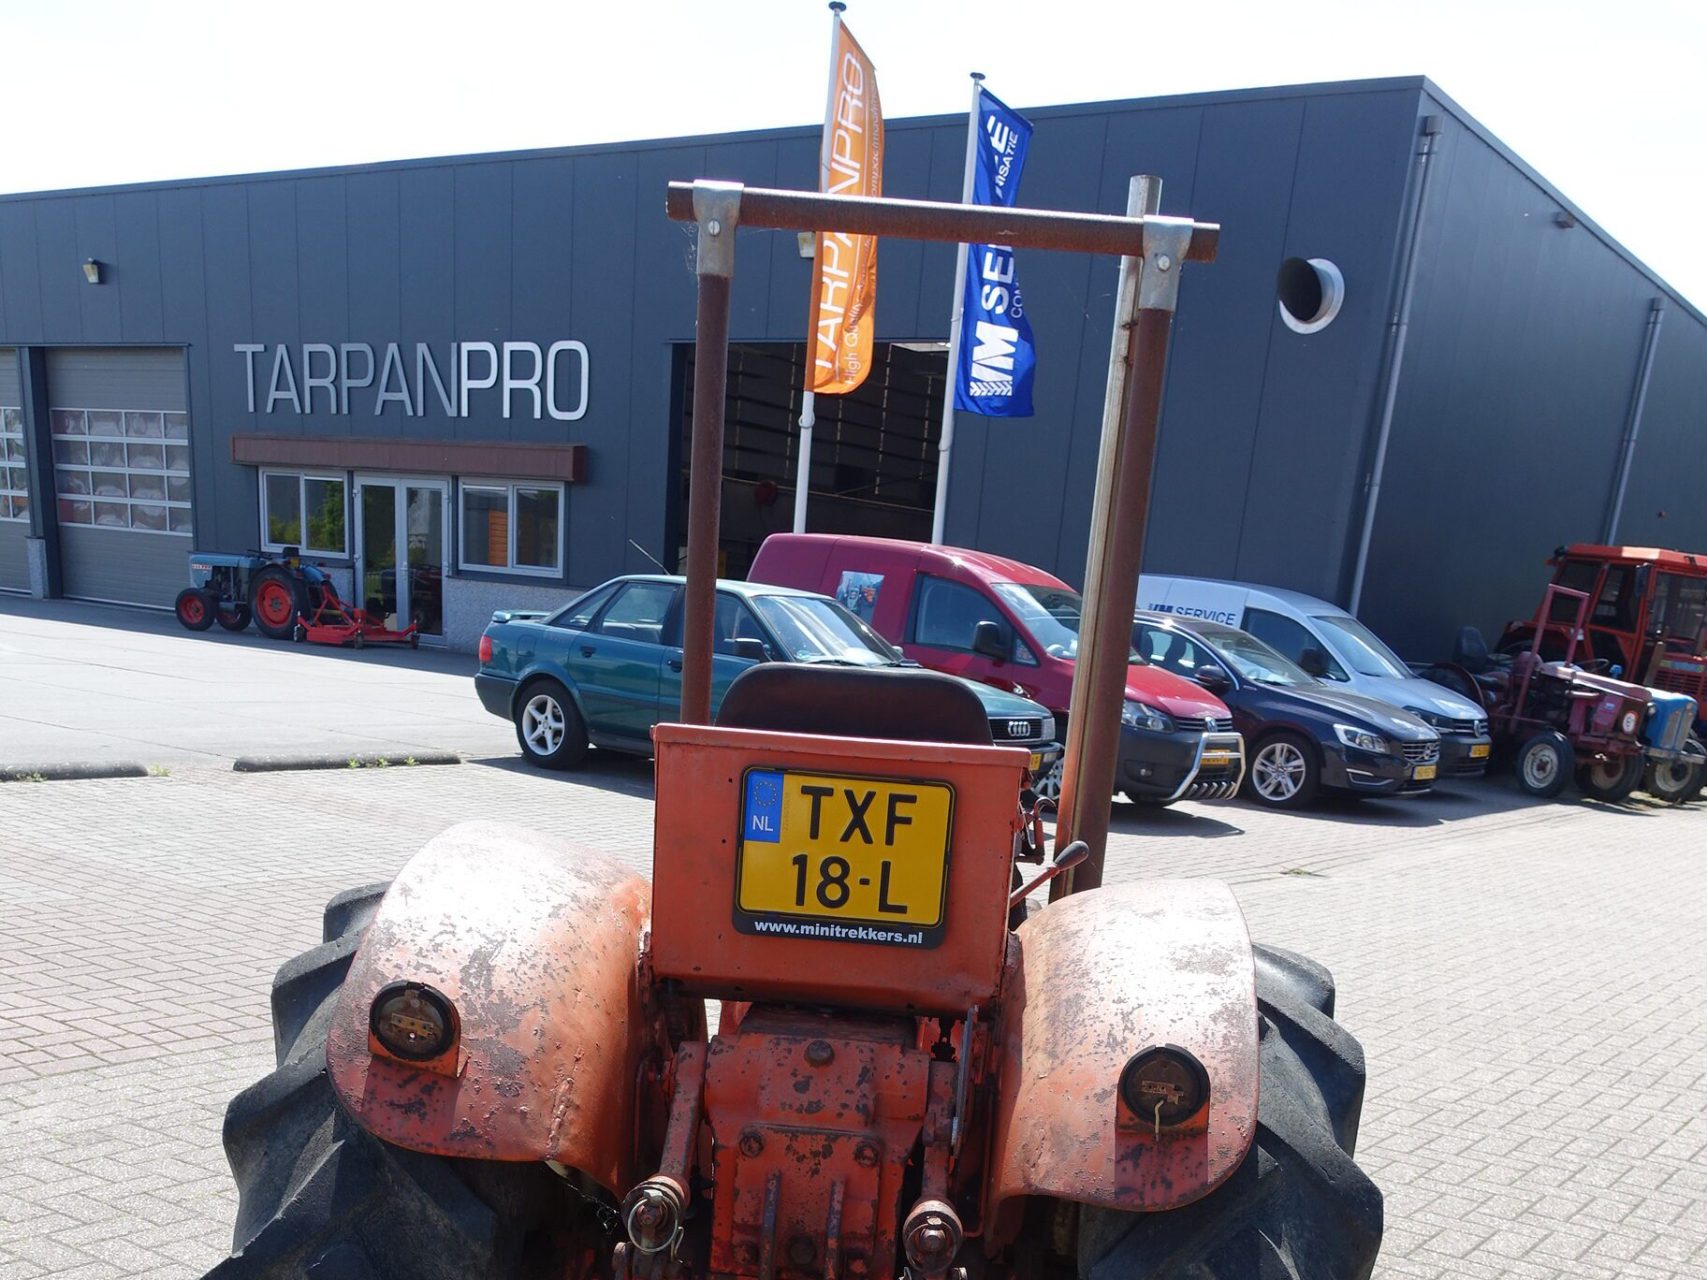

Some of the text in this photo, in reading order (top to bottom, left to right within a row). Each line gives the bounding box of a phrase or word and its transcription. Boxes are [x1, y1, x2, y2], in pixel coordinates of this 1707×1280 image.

[234, 340, 589, 421] TARPANPRO
[843, 352, 861, 385] High
[1176, 606, 1236, 626] SERVICE
[752, 815, 774, 832] NL
[801, 785, 917, 846] TXF
[792, 854, 908, 915] 18-L
[754, 921, 923, 944] www.minitrekkers.nl
